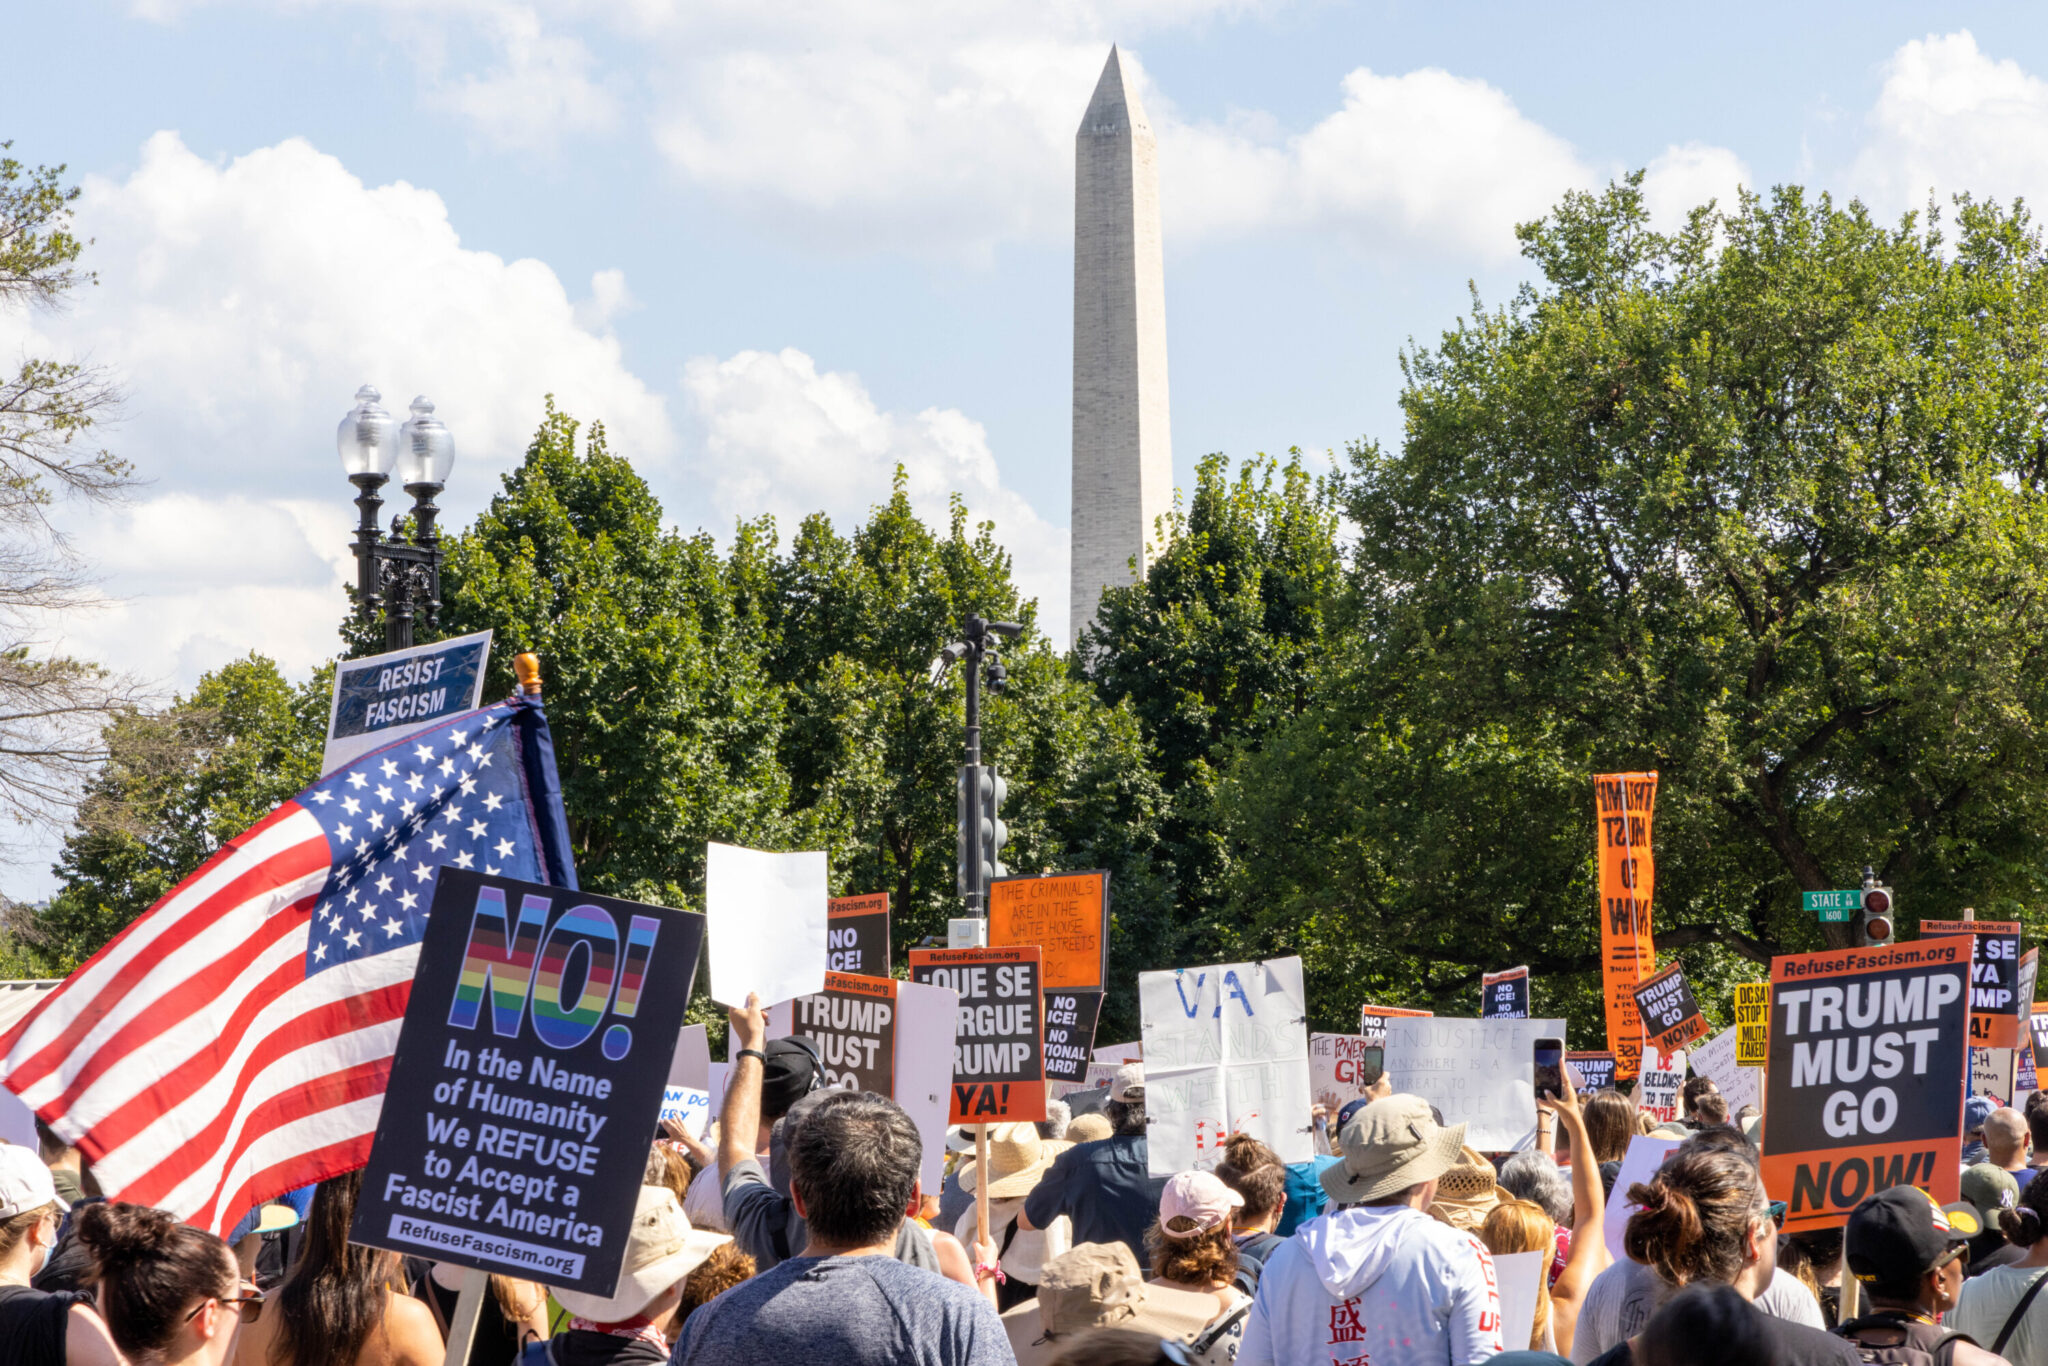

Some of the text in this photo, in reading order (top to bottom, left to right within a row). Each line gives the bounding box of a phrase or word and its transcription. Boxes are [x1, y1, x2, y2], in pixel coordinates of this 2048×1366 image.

[378, 657, 445, 693] RESIST
[365, 687, 447, 727] FASCISM
[1000, 880, 1094, 900] THE CRIMINALS
[828, 899, 882, 912] Fascism.org
[1012, 901, 1079, 919] ARE IN THE
[1811, 894, 1840, 907] STATE
[1825, 911, 1841, 920] 1600
[1010, 918, 1083, 937] WHITE HOUSE
[1927, 922, 2011, 932] RefuseFascism.org
[829, 928, 858, 949] NO
[1048, 935, 1095, 952] STREETS
[930, 951, 1020, 962] RefuseFascism.org
[1986, 939, 2016, 959] SE
[1784, 947, 1956, 977] RefuseFascism.org
[447, 885, 661, 1061] NO!
[996, 966, 1032, 998] SE
[825, 975, 889, 995] eFascism.org
[1176, 970, 1254, 1019] VA
[1498, 984, 1513, 993] NO
[1636, 973, 1682, 1006] TRUMP
[1054, 996, 1076, 1010] NO
[1495, 992, 1515, 1002] ICE!
[1646, 989, 1684, 1018] MUST
[1740, 987, 1753, 1004] DC
[1778, 973, 1961, 1035] TRUMP
[797, 995, 892, 1034] TRUMP
[1047, 1010, 1077, 1025] ICE!
[1498, 1004, 1511, 1012] NO
[1662, 1008, 1683, 1026] GO
[1738, 1005, 1761, 1022] STOP
[957, 1004, 1032, 1036] RGUE
[1365, 1017, 1381, 1027] NO
[1970, 1017, 1991, 1038] A!
[1049, 1029, 1068, 1043] NO
[1391, 1028, 1521, 1049] INJUSTICE
[1662, 1018, 1700, 1048] NOW!
[1742, 1026, 1767, 1042] MILITA
[1044, 1043, 1086, 1060] TIONAL
[1144, 1019, 1299, 1069] STANDS
[1311, 1036, 1331, 1056] THE
[1739, 1042, 1766, 1058] TAKEO
[953, 1043, 1031, 1075] RUMP
[1044, 1059, 1077, 1074] ARD!
[1391, 1058, 1500, 1070] ANYWHERE IS A
[1657, 1053, 1673, 1071] DC
[1791, 1028, 1939, 1088] MUST
[444, 1039, 612, 1100] In the Name
[1585, 1074, 1608, 1085] UST
[1161, 1066, 1283, 1112] WITH
[1452, 1077, 1465, 1090] TO
[1644, 1072, 1682, 1088] BELONGS
[688, 1094, 709, 1106] DO
[955, 1084, 1010, 1116] YA!
[1432, 1095, 1488, 1116] TICE
[1646, 1092, 1655, 1104] TO
[1660, 1093, 1675, 1106] THE
[433, 1078, 608, 1142] of Humanity
[1823, 1086, 1898, 1138] GO
[426, 1112, 600, 1176] We REFUSE
[424, 1149, 579, 1207] to Accept a
[1791, 1151, 1936, 1213] NOW!
[383, 1173, 604, 1248] Fascist America
[399, 1220, 576, 1275] RefuseFascism.org
